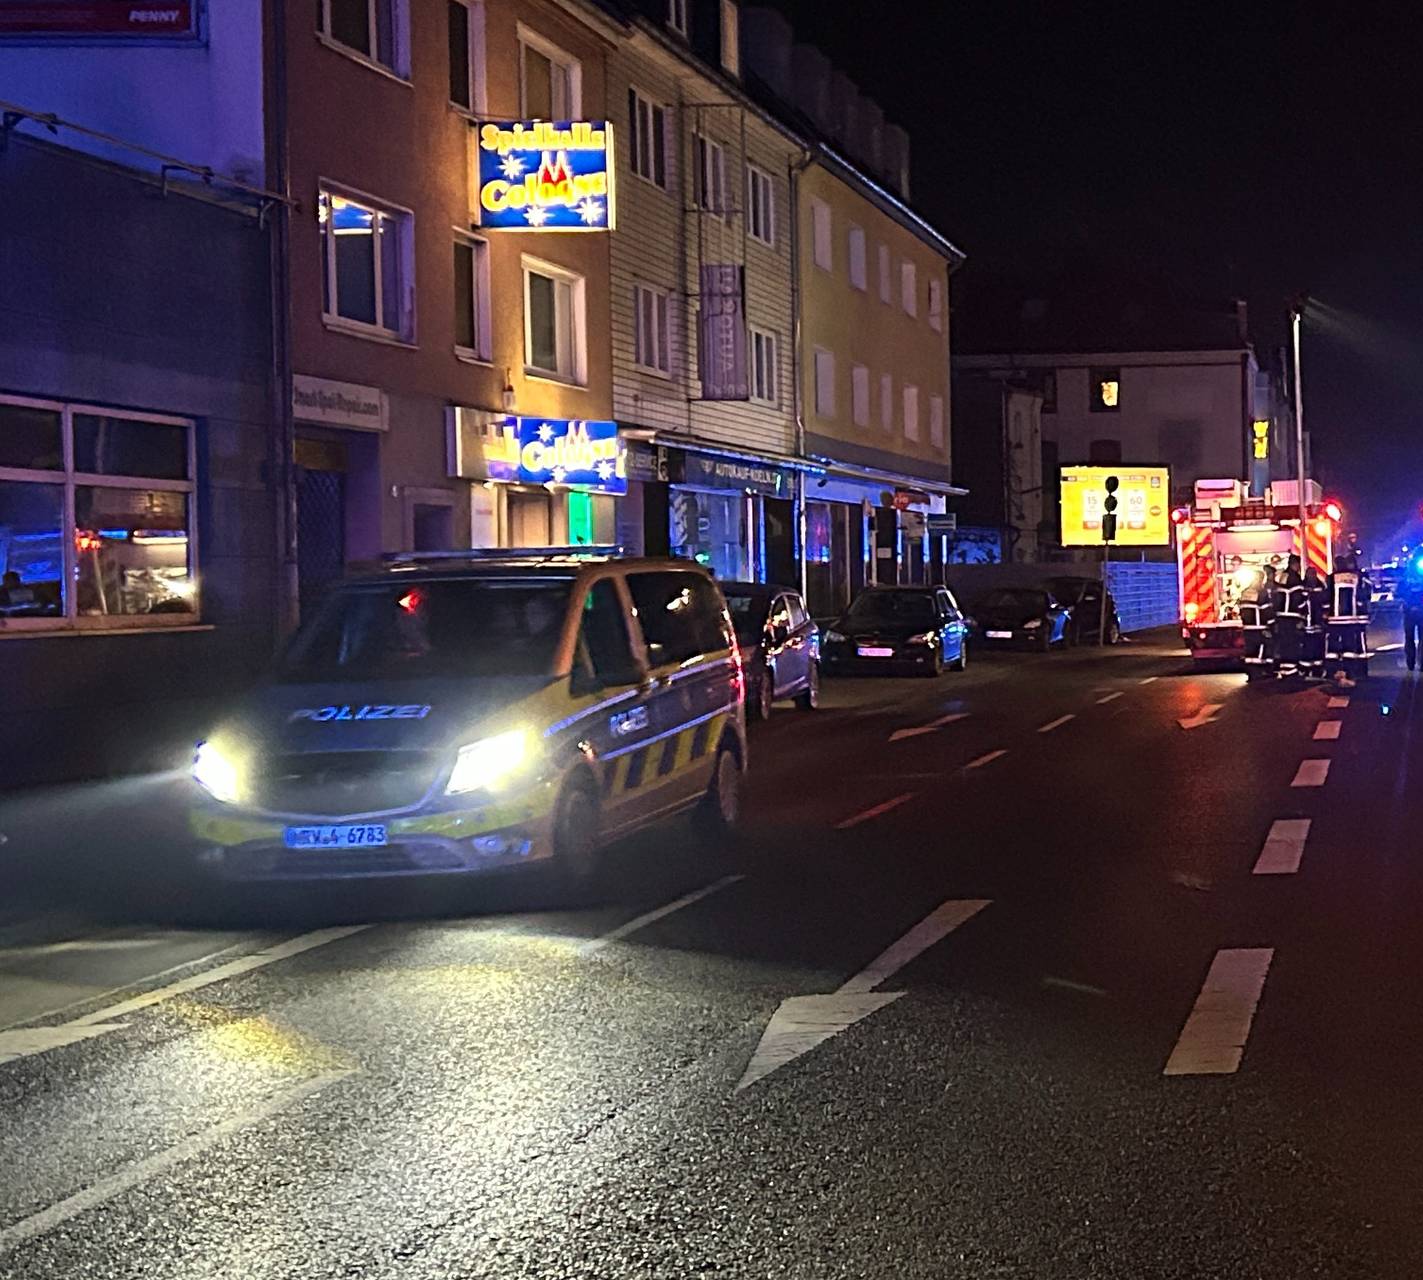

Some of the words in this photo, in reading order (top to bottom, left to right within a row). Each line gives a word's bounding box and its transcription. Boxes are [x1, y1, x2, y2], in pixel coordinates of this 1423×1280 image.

[129, 10, 179, 22] PENNY
[480, 123, 606, 155] Spielhalle
[480, 171, 608, 212] Cologne
[289, 704, 431, 722] POLIZEI
